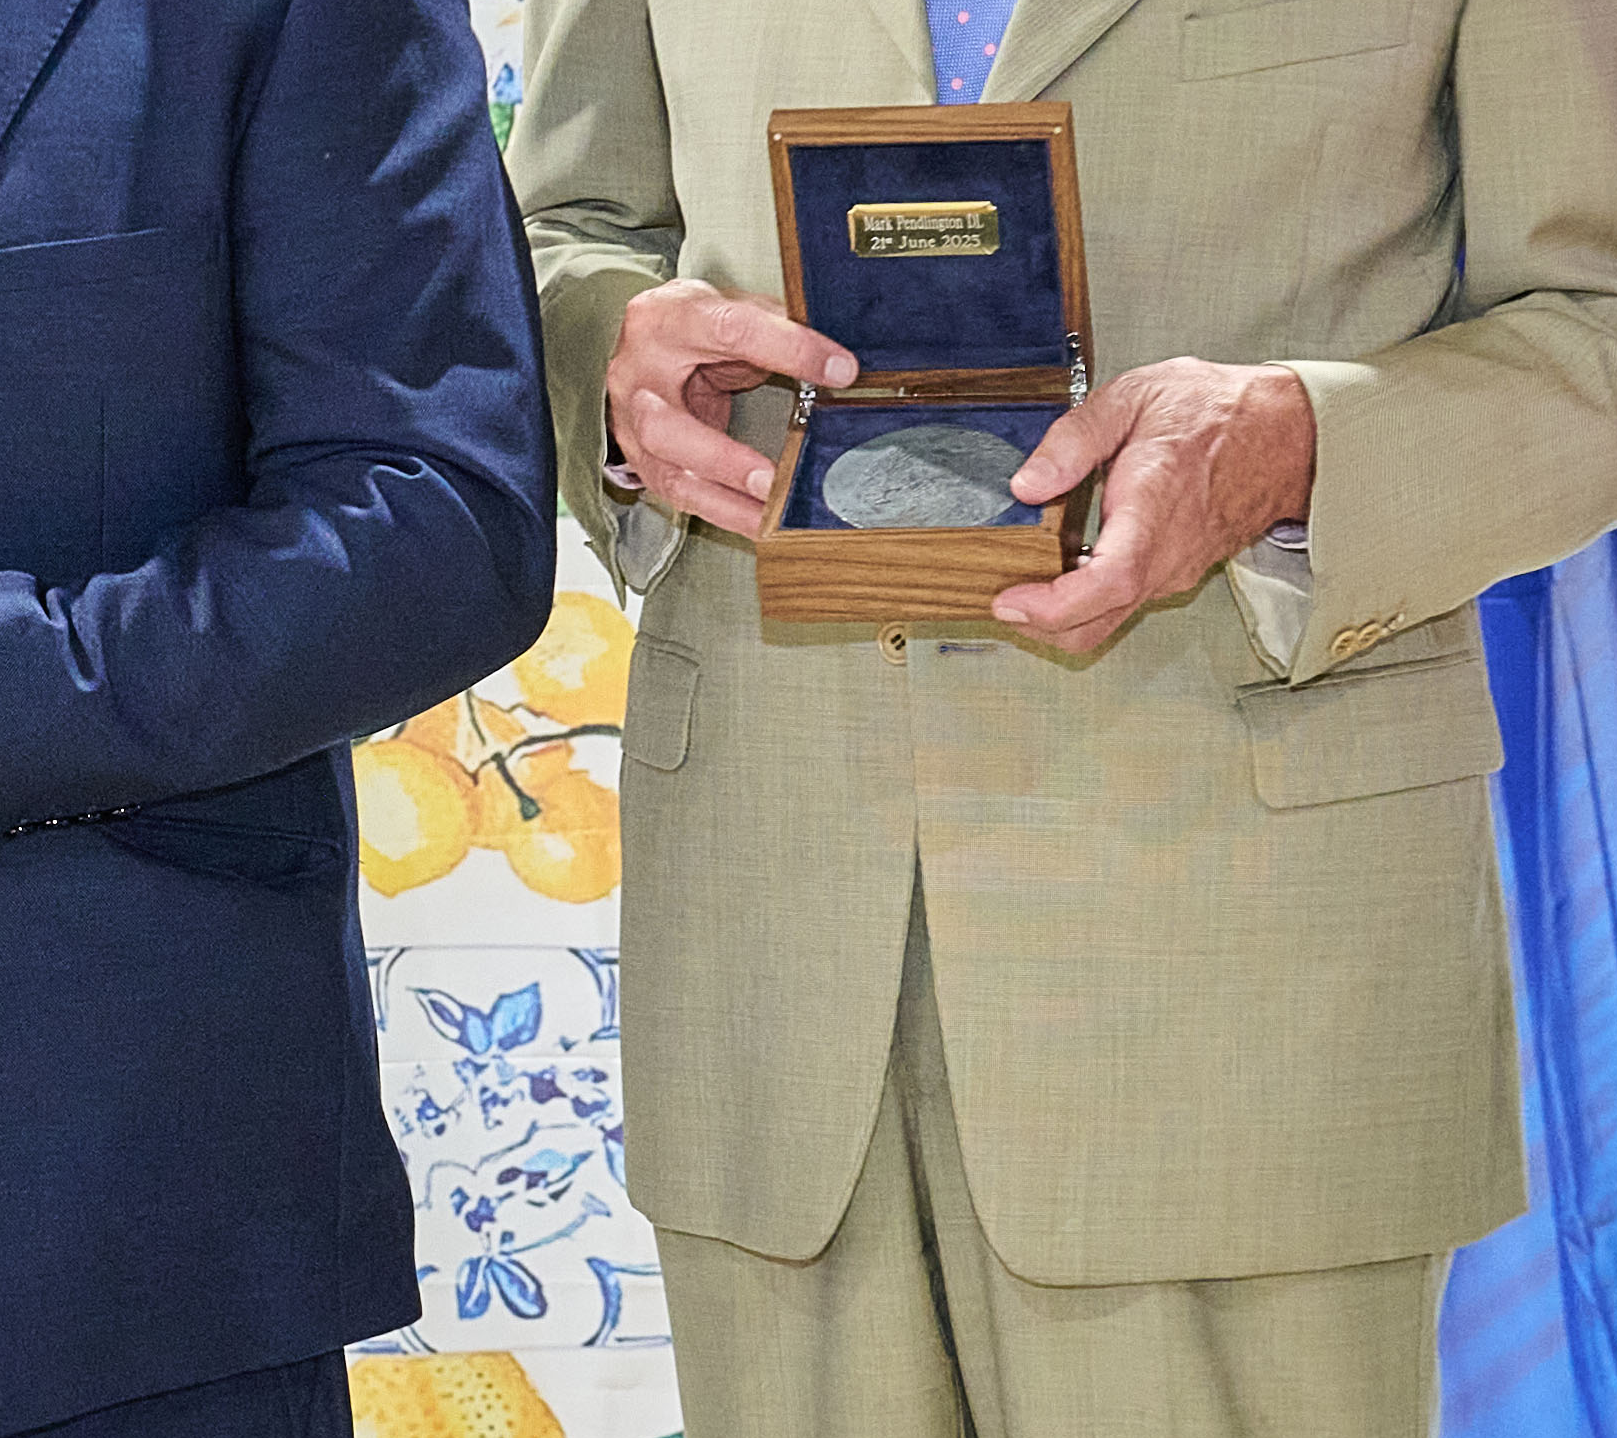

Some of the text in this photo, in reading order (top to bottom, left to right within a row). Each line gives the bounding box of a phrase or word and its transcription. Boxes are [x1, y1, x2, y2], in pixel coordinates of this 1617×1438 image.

[864, 216, 893, 232] Mark
[898, 235, 936, 249] June
[941, 234, 982, 248] 2025
